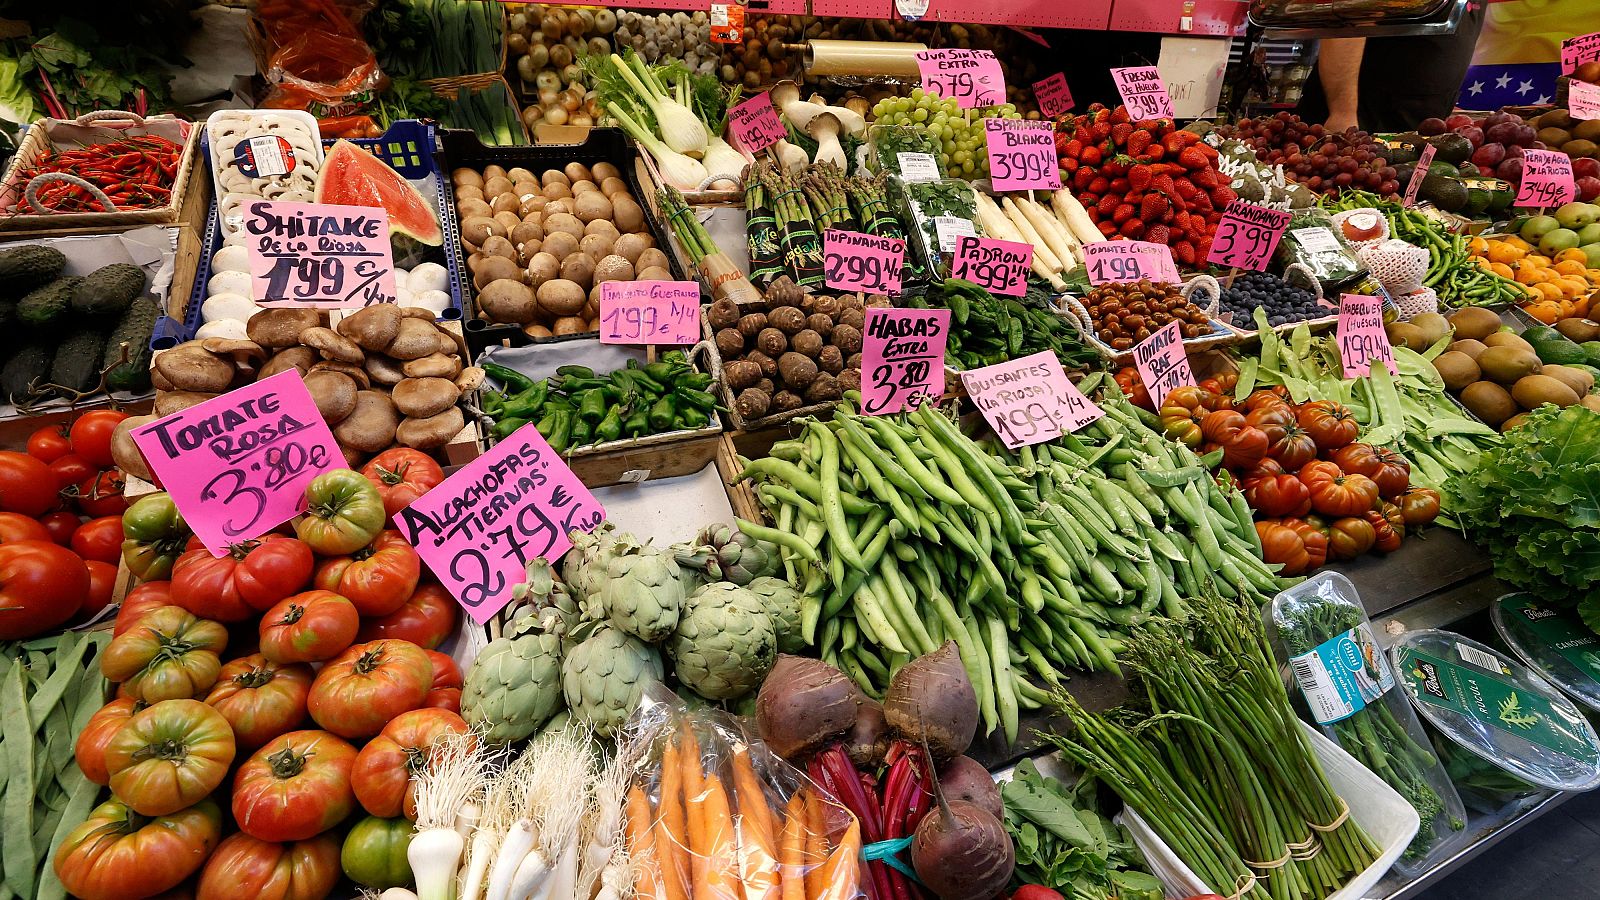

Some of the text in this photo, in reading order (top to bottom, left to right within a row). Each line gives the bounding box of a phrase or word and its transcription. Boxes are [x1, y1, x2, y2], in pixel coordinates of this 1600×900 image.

[917, 52, 946, 61] UVA
[949, 49, 970, 60] SIN
[938, 59, 980, 70] EXTRA
[1001, 131, 1053, 147] BLANCO
[991, 152, 1042, 181] 3'99
[1518, 181, 1556, 203] 3'49
[824, 228, 903, 253] TUPINAMBO
[960, 237, 1027, 264] PADRON
[1082, 243, 1127, 255] TOMATE
[1213, 223, 1273, 259] 3'99
[825, 253, 881, 289] 2'99
[955, 261, 1010, 290] 1'99
[1090, 257, 1141, 281] 1'99
[602, 306, 658, 338] 1'99
[868, 313, 941, 340] HABAS
[1134, 325, 1176, 366] TOMATE
[1148, 350, 1172, 379] RAF
[864, 360, 930, 413] 3'80
[962, 363, 1051, 397] GUISANTES
[139, 392, 280, 460] TOMATE
[208, 413, 305, 460] ROSA
[995, 402, 1059, 446] 1'99
[400, 442, 541, 547] ALCACHOFAS
[449, 503, 559, 608] 2'79
[1343, 641, 1361, 667] Bimi
